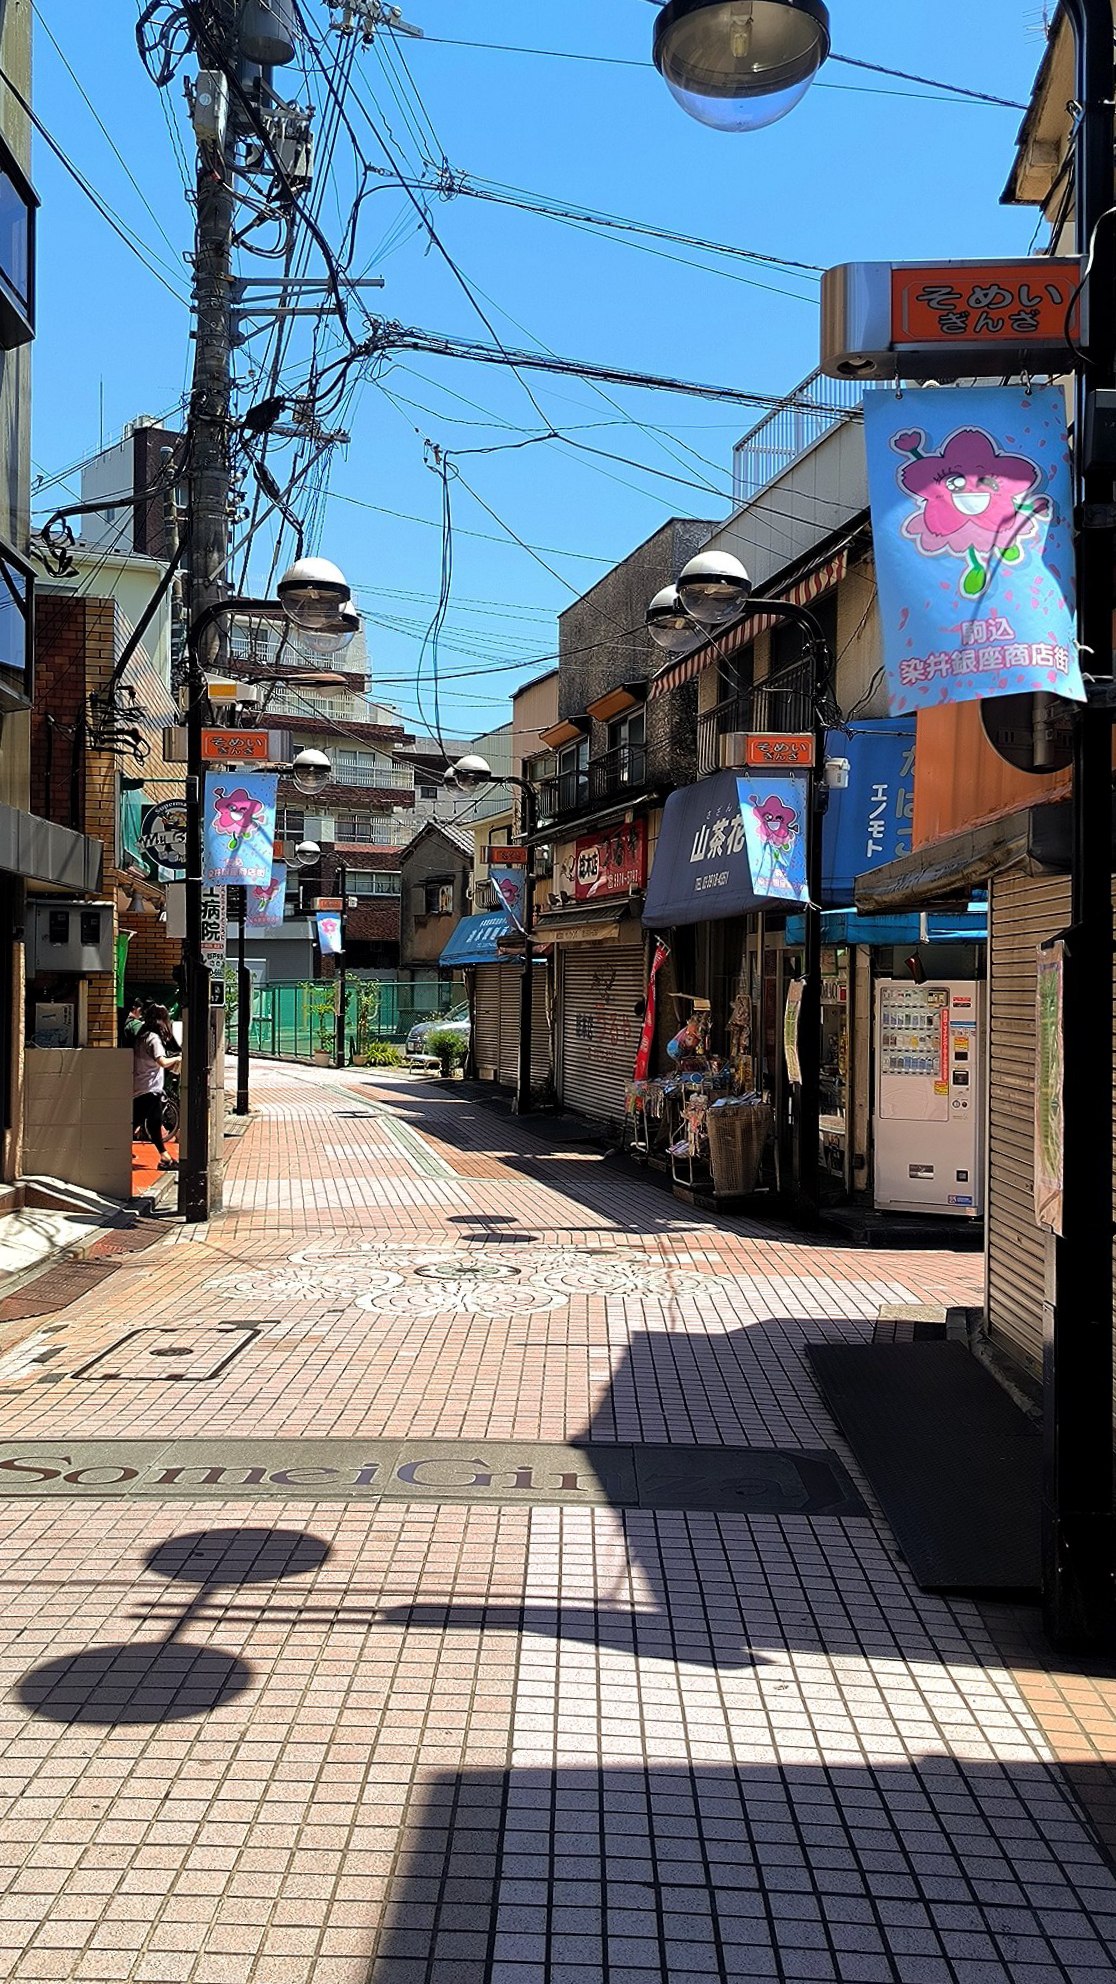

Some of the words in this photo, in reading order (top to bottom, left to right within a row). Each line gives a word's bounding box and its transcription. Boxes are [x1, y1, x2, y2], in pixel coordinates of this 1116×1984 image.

[916, 284, 1063, 310] そめい
[938, 309, 1040, 334] ぎんざ
[960, 618, 1016, 646] 駒込
[900, 643, 1069, 685] 染井銀座商店街
[210, 737, 262, 747] そめい
[756, 742, 807, 753] そめい
[866, 784, 888, 858] エノモト
[690, 814, 745, 863] 山茶花
